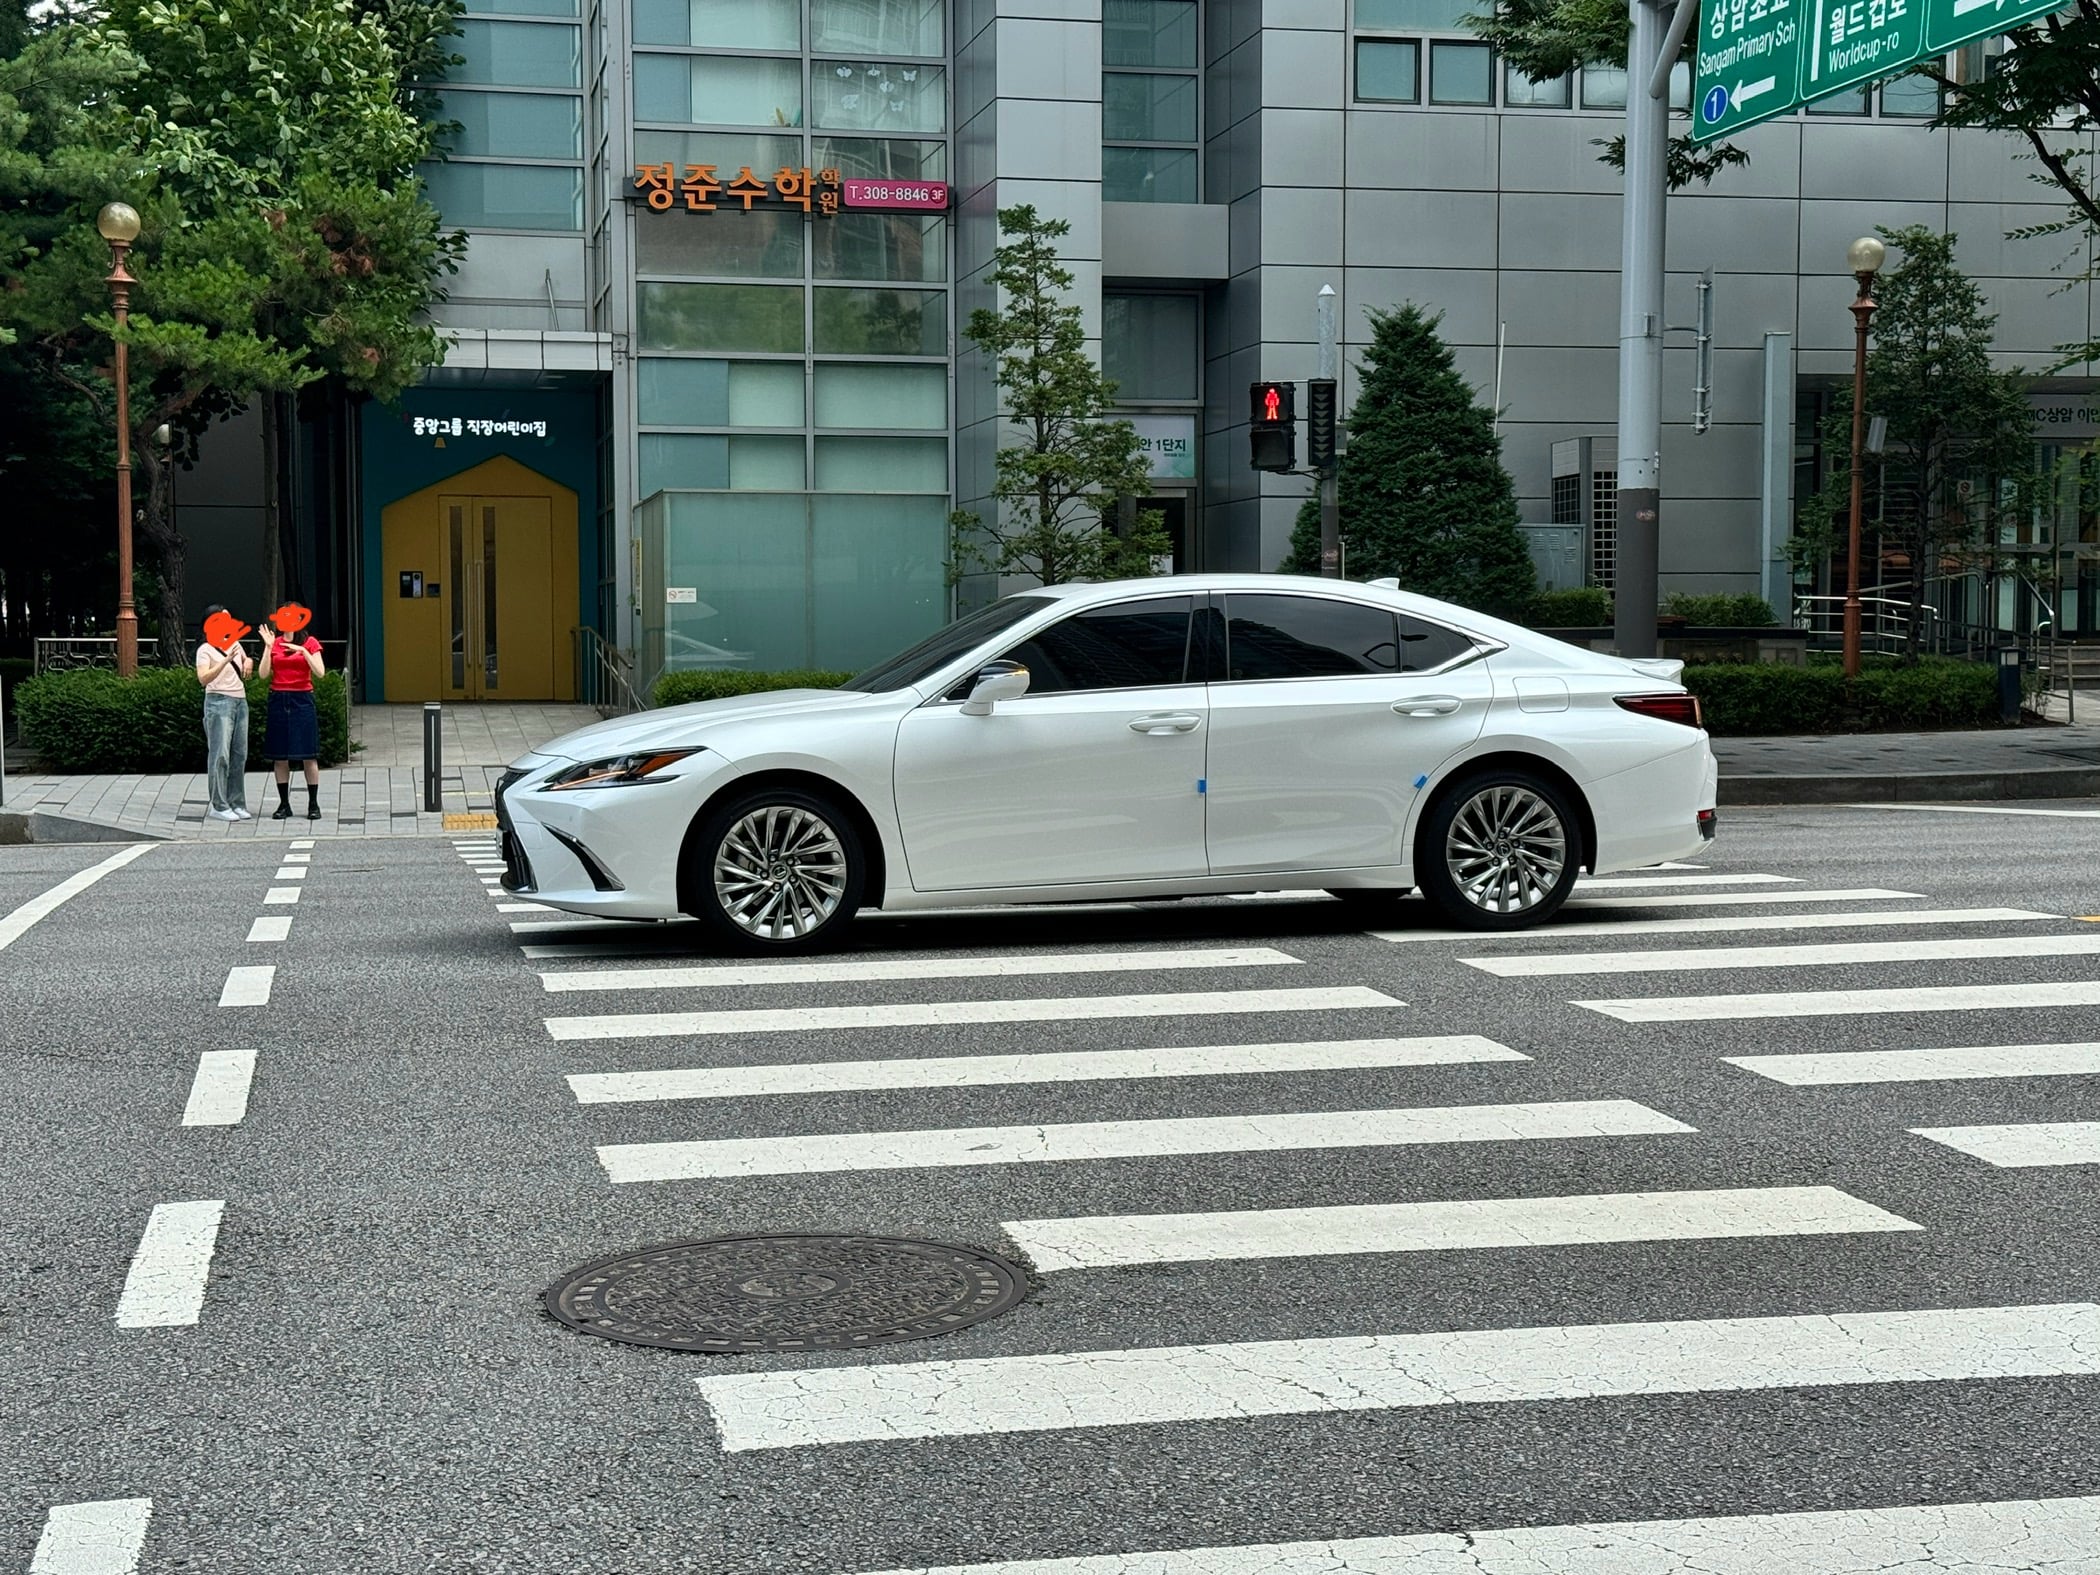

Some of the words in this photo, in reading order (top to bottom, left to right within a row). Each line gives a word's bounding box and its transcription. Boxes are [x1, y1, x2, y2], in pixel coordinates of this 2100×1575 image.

[1699, 46, 1736, 77] Sangam
[1736, 30, 1775, 62] Primary
[1775, 17, 1796, 47] Sch
[1710, 91, 1718, 119] 1
[634, 162, 817, 213] 정준수학
[849, 185, 929, 202] T.308-8846
[931, 189, 945, 201] 3F
[2024, 408, 2074, 423] MC상암
[413, 417, 463, 436] 중앙그룹
[466, 420, 547, 437] 직장어린이집
[1155, 438, 1187, 452] 1단지
